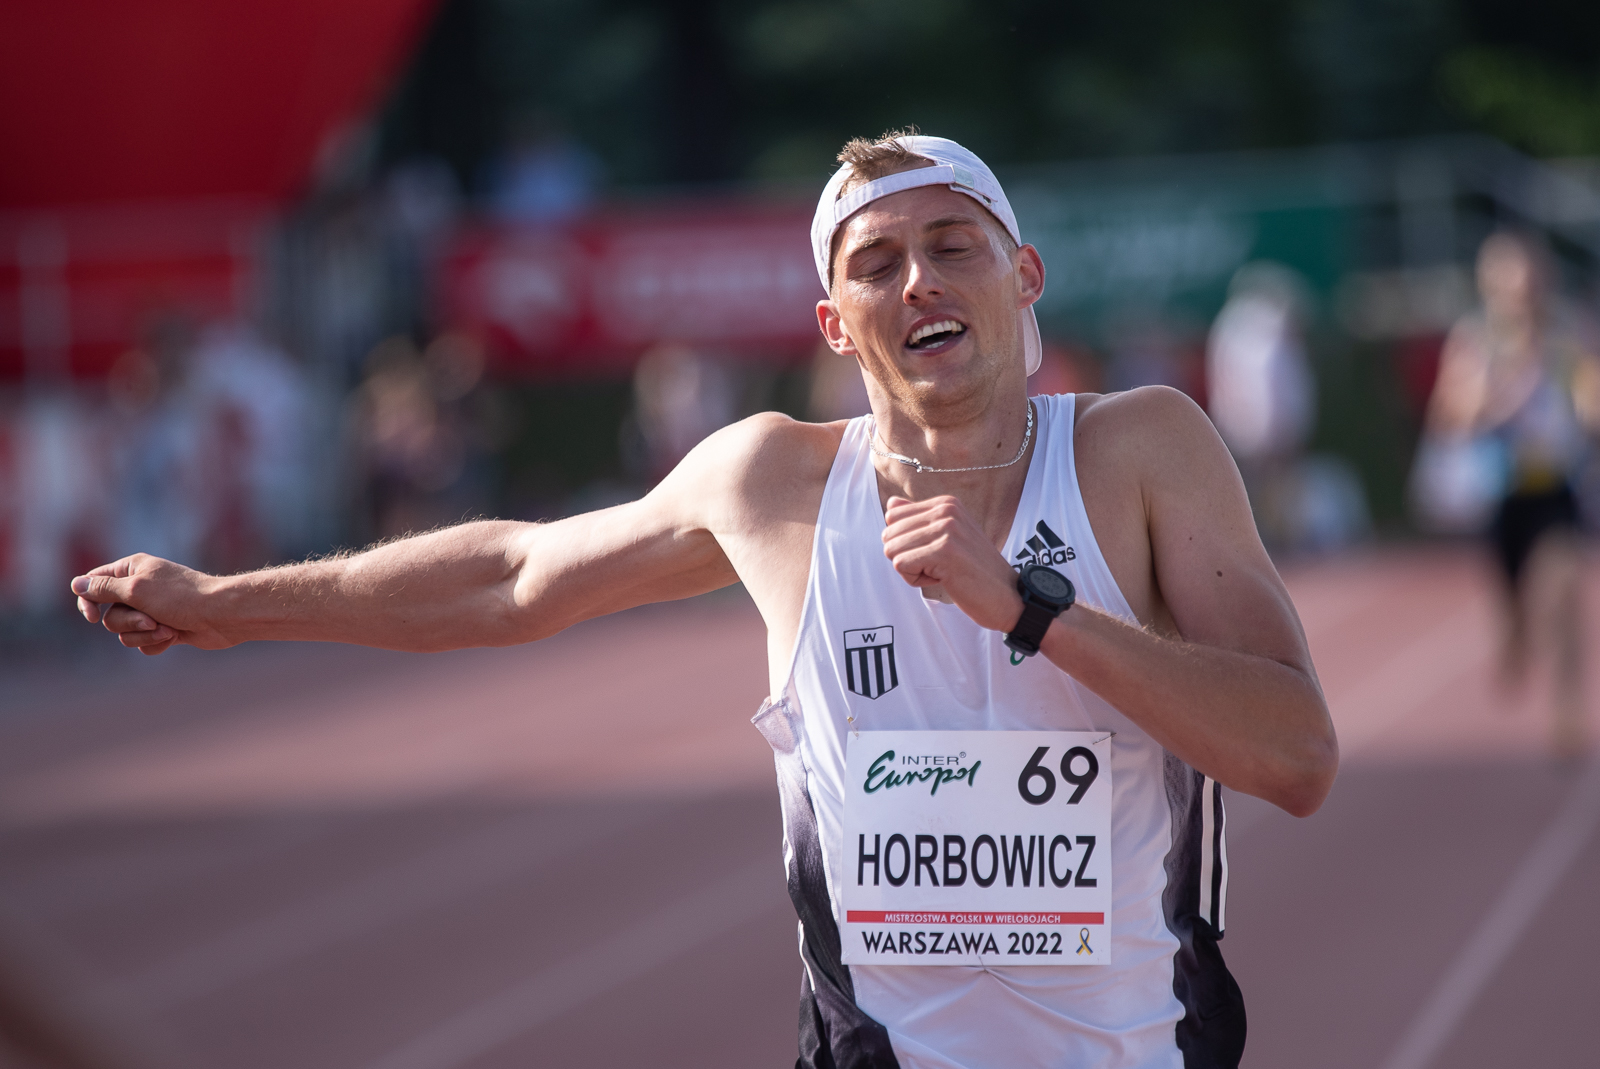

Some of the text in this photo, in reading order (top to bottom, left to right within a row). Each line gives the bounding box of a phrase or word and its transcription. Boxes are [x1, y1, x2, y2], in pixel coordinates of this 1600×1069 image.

[861, 632, 877, 644] W
[863, 749, 982, 796] Europol
[1017, 746, 1099, 806] 69
[857, 833, 1098, 888] HORBOWICZ
[884, 913, 1061, 924] MISTRZOSTWA POLSKI W WIELOBOJACH
[861, 931, 1063, 955] WARSZAWA 2022
